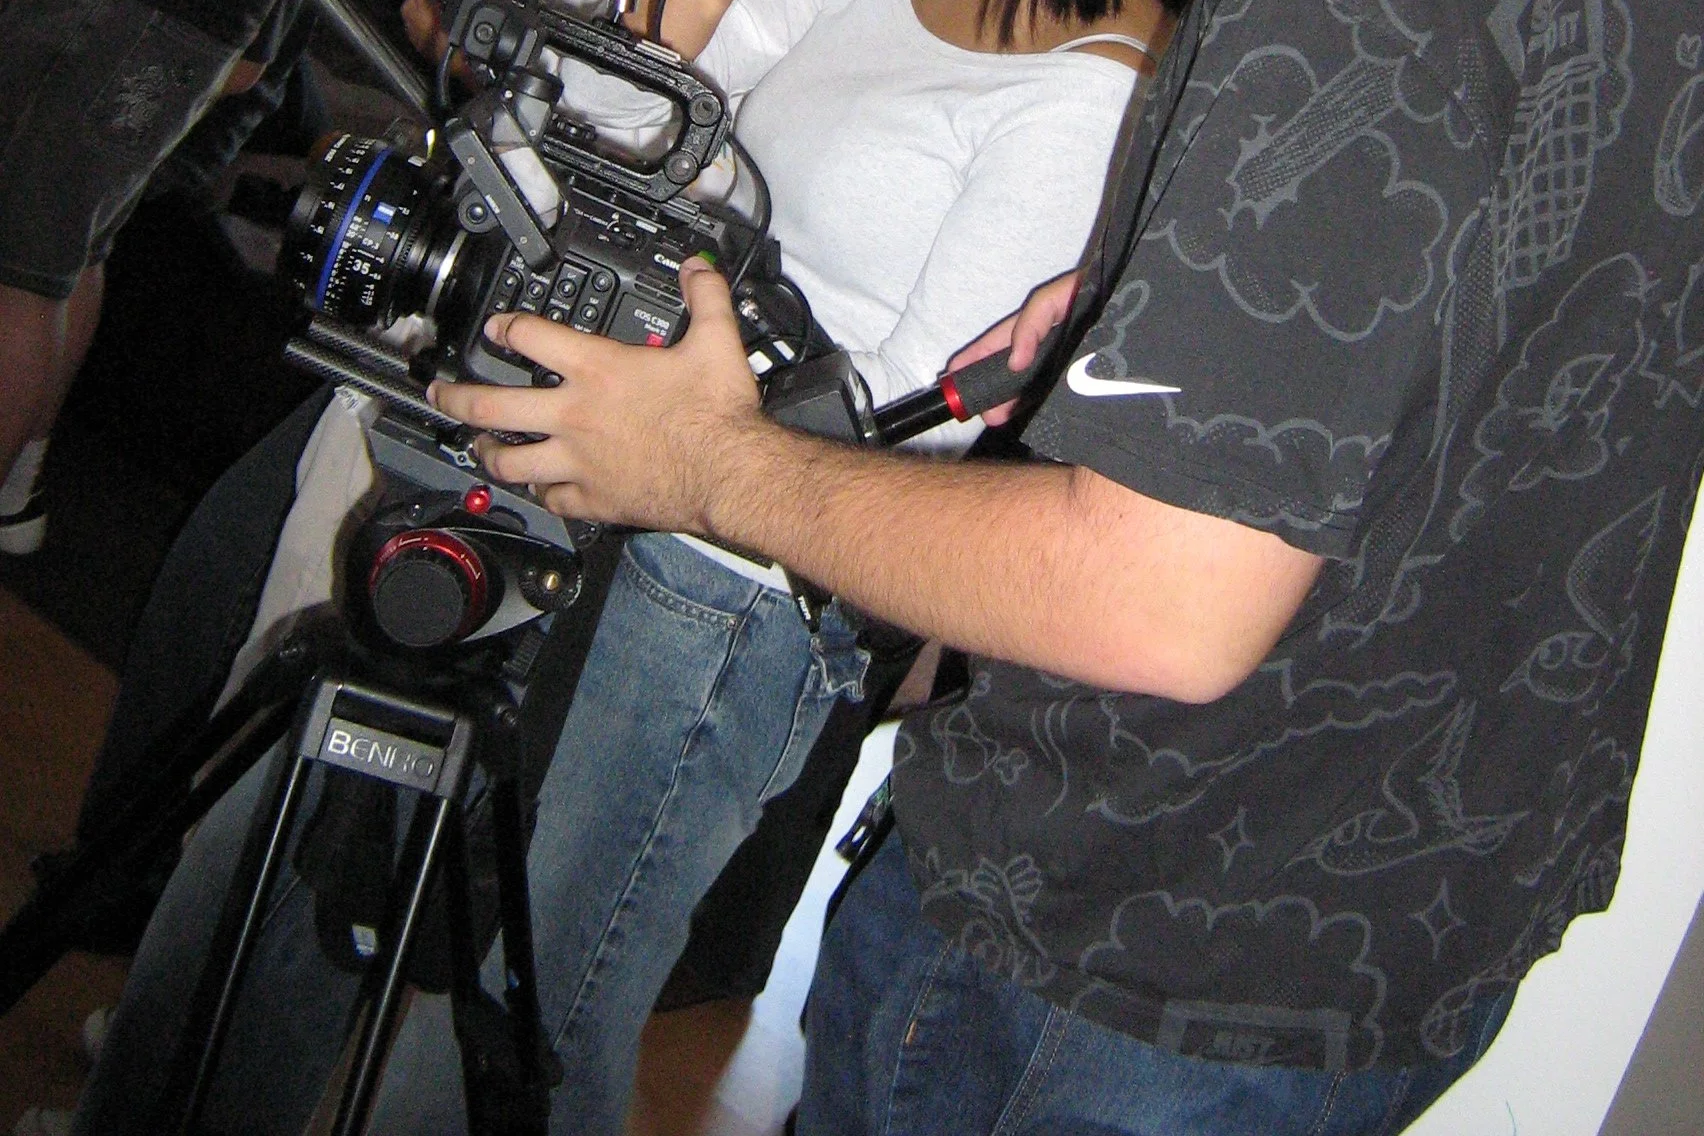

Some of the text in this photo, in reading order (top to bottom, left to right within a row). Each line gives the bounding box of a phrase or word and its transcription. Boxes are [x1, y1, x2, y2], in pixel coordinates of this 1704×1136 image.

[352, 259, 371, 275] 35
[653, 253, 681, 271] Can
[633, 308, 652, 322] EOS
